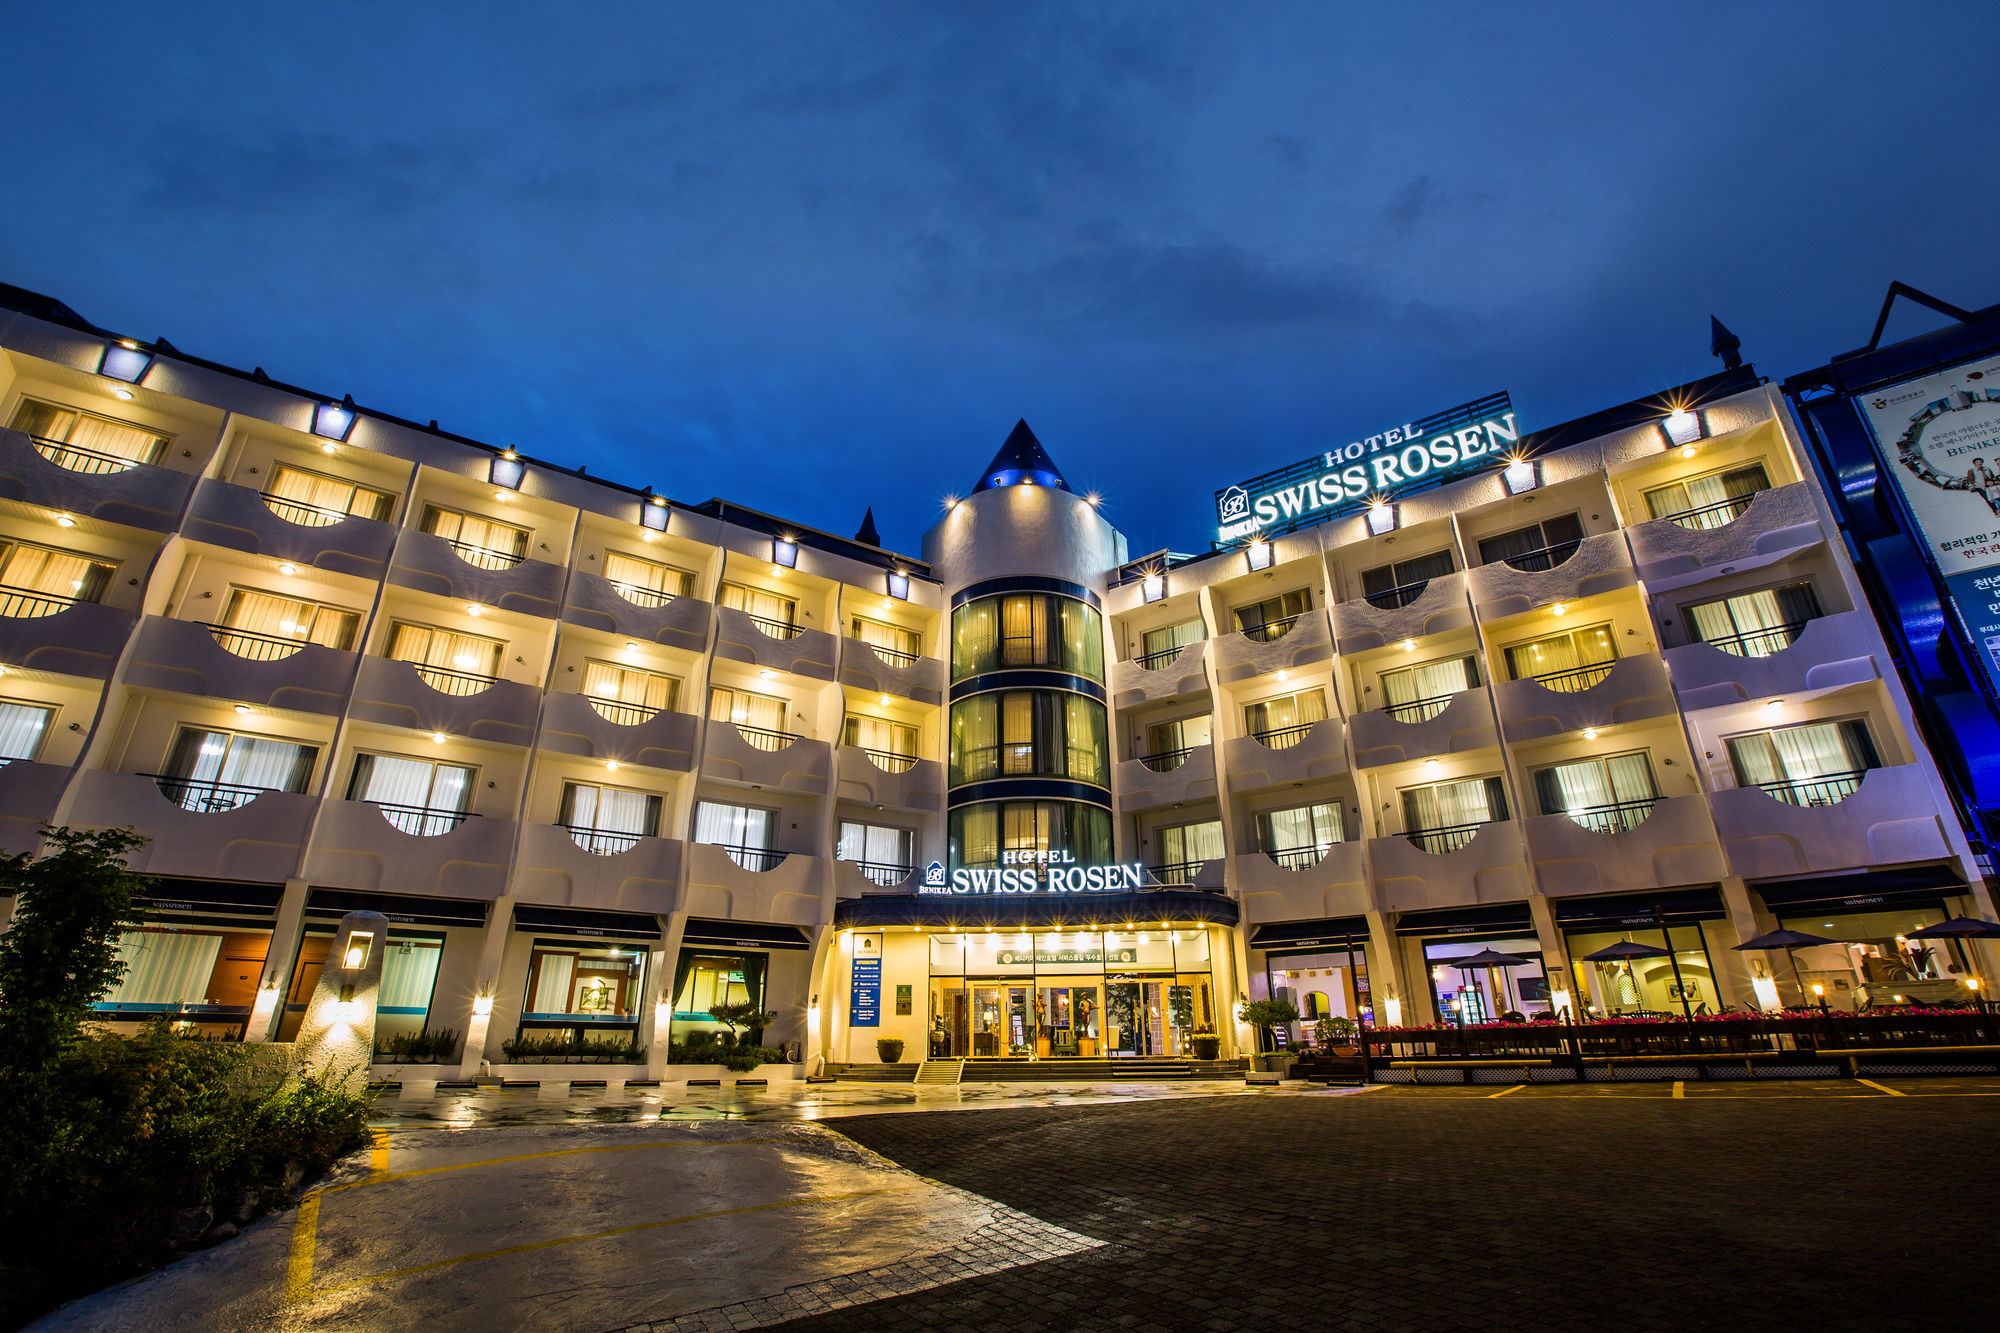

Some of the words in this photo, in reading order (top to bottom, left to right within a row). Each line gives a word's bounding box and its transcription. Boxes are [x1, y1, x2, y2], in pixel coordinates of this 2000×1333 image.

[1326, 423, 1424, 468] HOTEL
[1255, 465, 1368, 525] SWISS
[1371, 414, 1518, 489] ROSEN
[1940, 533, 1988, 552] 합리적인
[1003, 850, 1076, 865] HOTEL
[952, 868, 1037, 894] SWISS
[1048, 862, 1142, 892] ROSEN
[919, 886, 953, 896] BENIKEA
